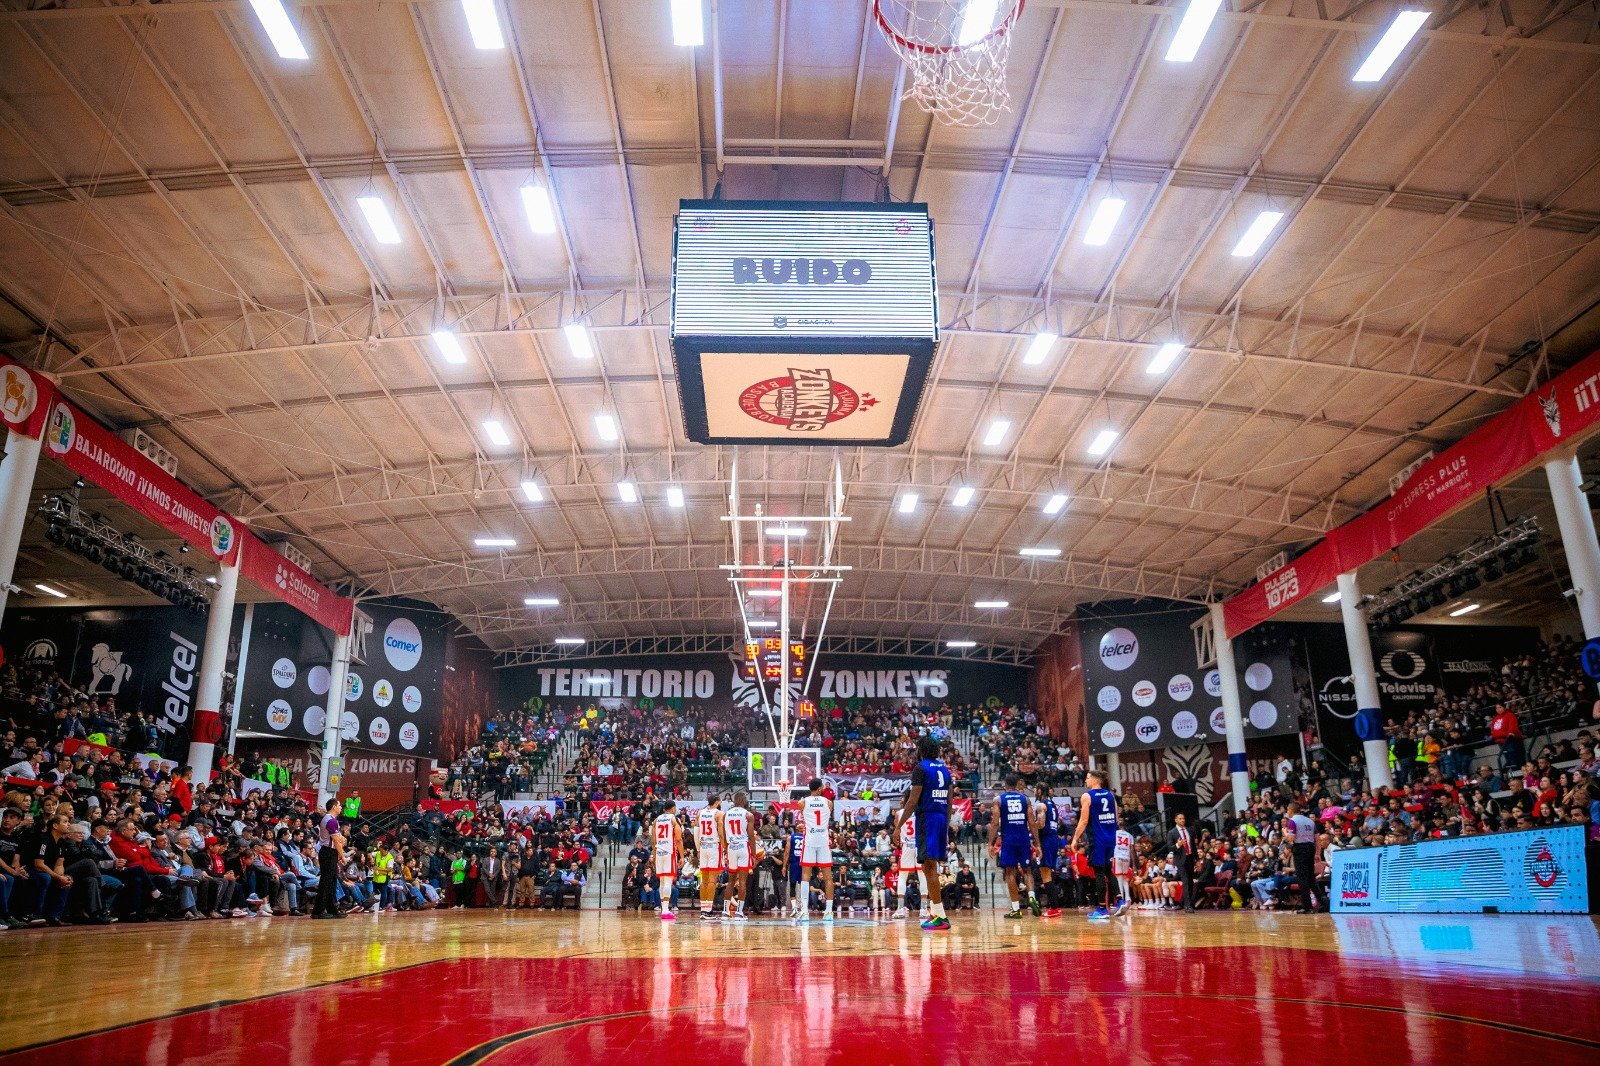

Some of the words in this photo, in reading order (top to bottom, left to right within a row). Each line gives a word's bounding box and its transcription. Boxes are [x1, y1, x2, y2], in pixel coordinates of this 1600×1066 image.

[733, 257, 873, 286] RUIDO
[742, 381, 779, 422] BASQUETBOL
[787, 367, 832, 431] ZONKEYS
[838, 388, 855, 416] TIJUANA
[1439, 455, 1467, 480] PLUS
[1436, 469, 1469, 494] MARRIOTT
[171, 500, 211, 537] ZONKEYS!
[385, 636, 420, 653] Comex
[1101, 641, 1137, 657] telcel
[156, 630, 198, 734] telcel
[272, 668, 296, 680] SPALDING
[537, 669, 715, 699] TERRITORIO
[820, 669, 949, 699] ZONKEYS
[1379, 682, 1435, 694] Televisa
[800, 702, 813, 717] 14
[350, 758, 416, 774] ZONKEYS
[872, 777, 913, 793] RAYAD
[1006, 799, 1023, 813] 55
[1100, 797, 1110, 812] 2
[813, 810, 821, 826] 1
[657, 823, 669, 839] 21
[700, 820, 713, 836] 13
[728, 819, 742, 836] 11
[1117, 836, 1129, 847] 34
[1343, 861, 1370, 870] TEMPORADA
[1341, 869, 1370, 893] 2024
